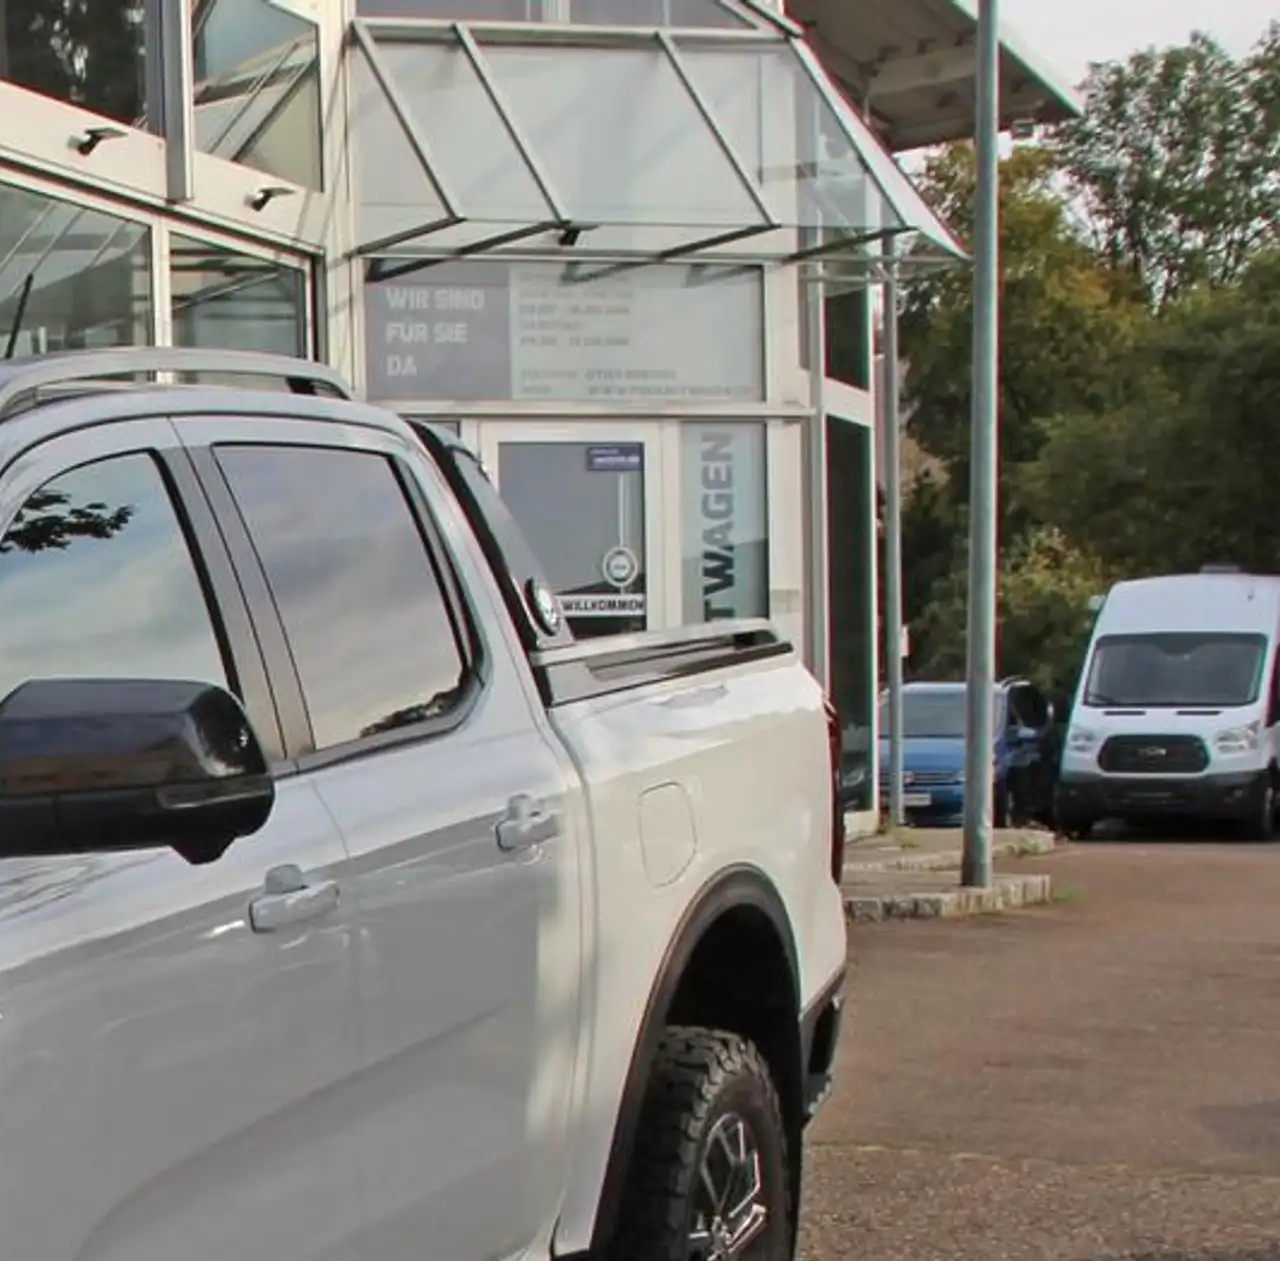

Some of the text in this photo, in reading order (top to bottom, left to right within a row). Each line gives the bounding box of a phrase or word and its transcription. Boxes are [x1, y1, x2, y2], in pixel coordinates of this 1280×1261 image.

[384, 287, 485, 311] WIR SIND
[384, 318, 469, 345] FÜR SIE
[386, 354, 418, 377] DA
[563, 598, 645, 613] WILLKOMMEN
